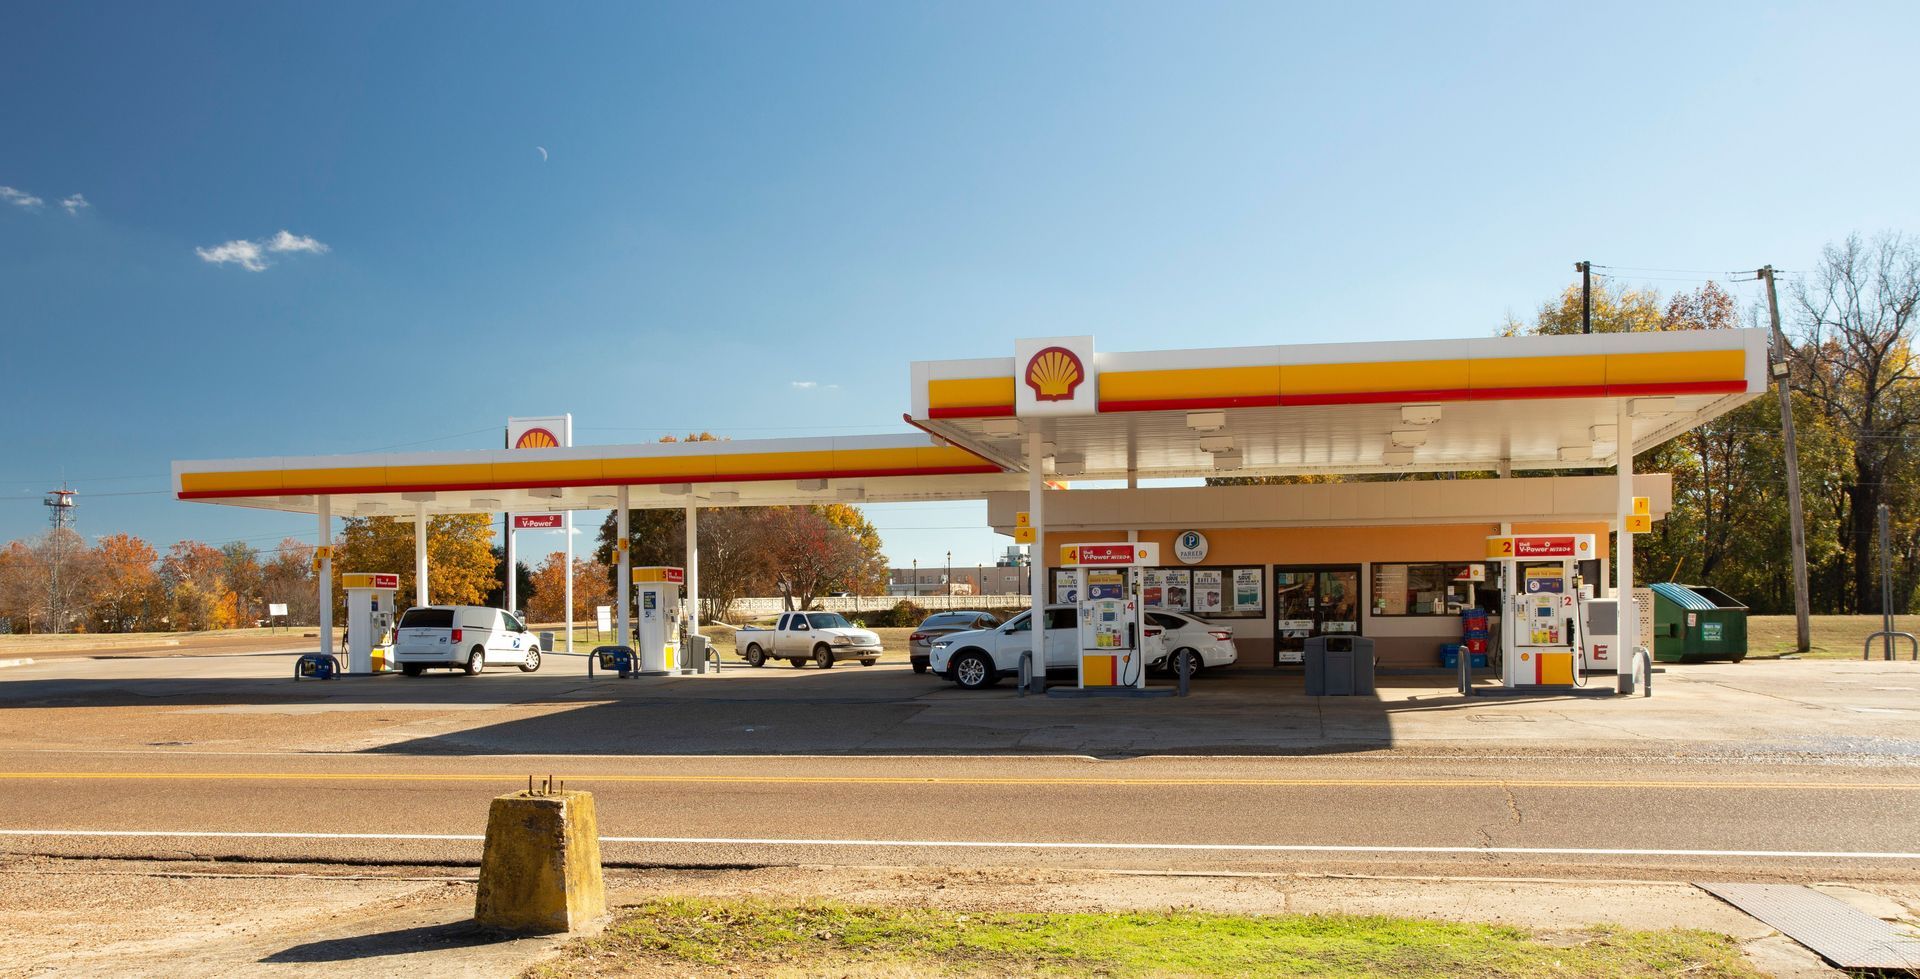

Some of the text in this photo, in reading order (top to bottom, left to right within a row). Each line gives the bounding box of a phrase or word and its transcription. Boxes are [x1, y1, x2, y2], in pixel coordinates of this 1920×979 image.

[1503, 541, 1512, 553] 2
[1069, 550, 1077, 561] 4
[1127, 601, 1135, 611] 4
[1564, 596, 1572, 606] 2
